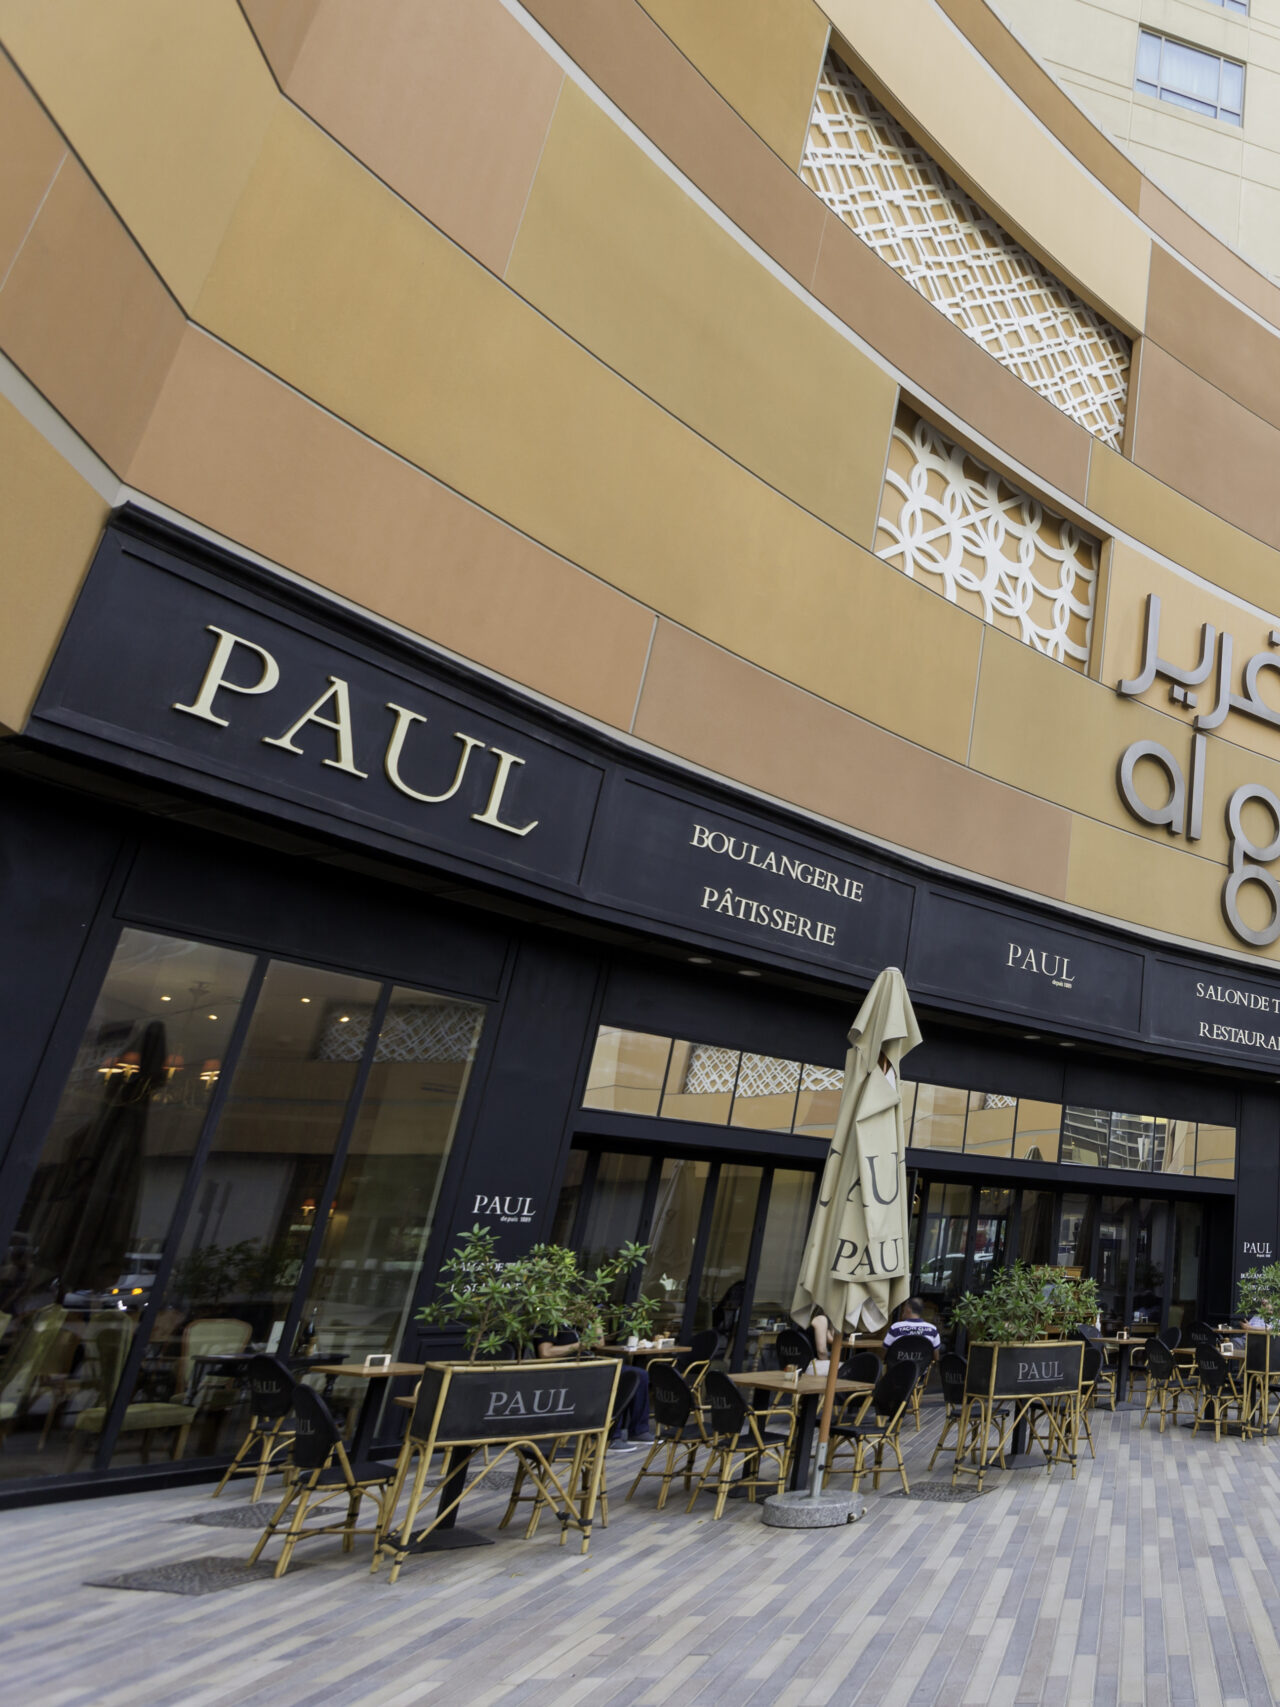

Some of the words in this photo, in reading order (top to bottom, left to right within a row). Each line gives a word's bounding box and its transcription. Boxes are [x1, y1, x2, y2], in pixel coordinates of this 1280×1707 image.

[172, 624, 539, 837] PAUL
[1116, 732, 1207, 841] al
[689, 823, 865, 903] BOULANGERIE
[700, 886, 837, 947] PÂTISSERIE
[1005, 942, 1076, 982] PAUL
[1196, 982, 1249, 1007] SALON
[1249, 993, 1270, 1012] DE
[471, 1194, 537, 1216] PAUL
[830, 1236, 904, 1276] PAU
[1243, 1241, 1273, 1254] PAUL
[897, 1351, 923, 1361] PAUL
[1017, 1361, 1064, 1380] PAUL
[485, 1387, 576, 1417] PAUL
